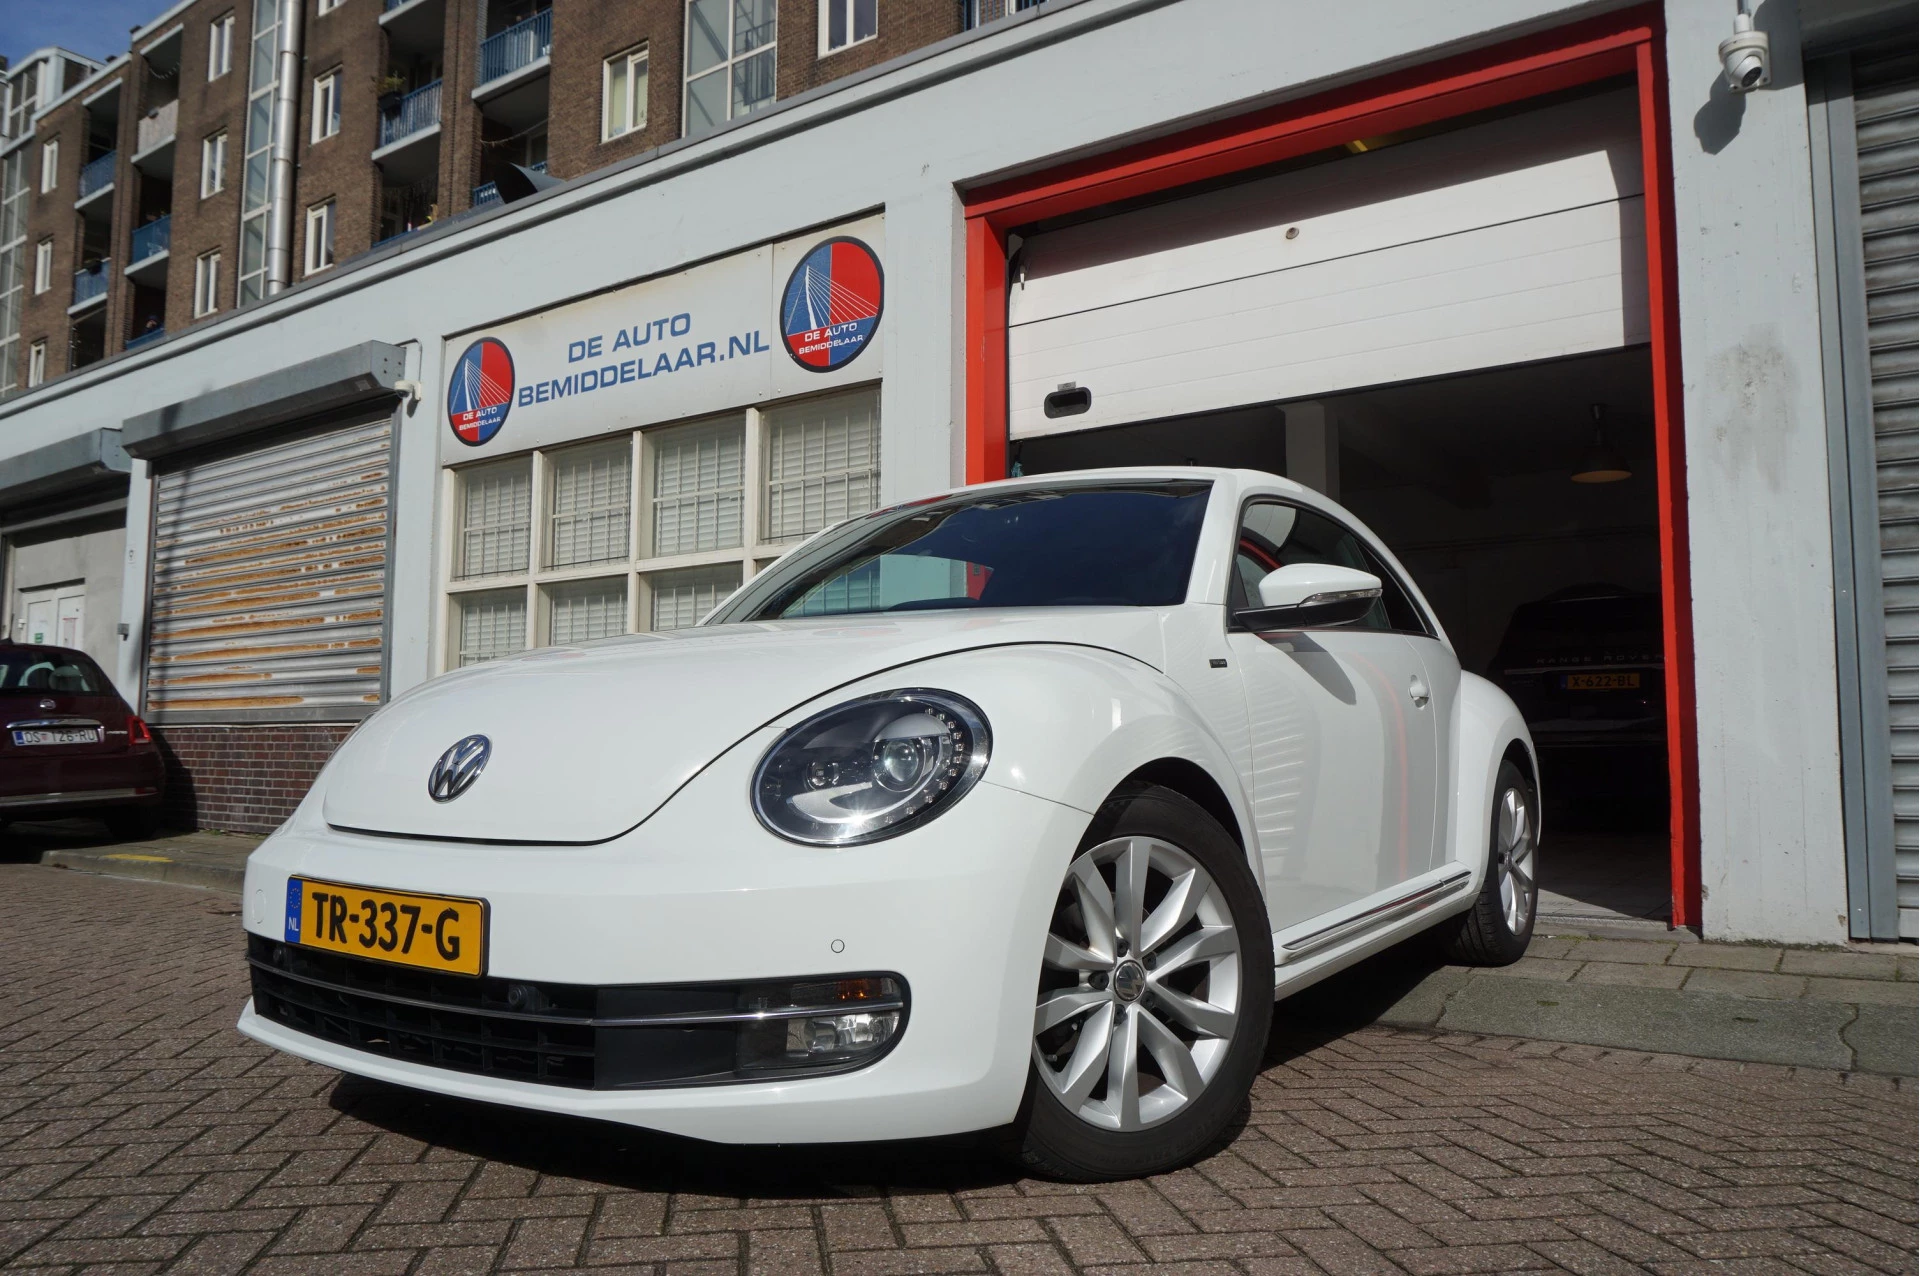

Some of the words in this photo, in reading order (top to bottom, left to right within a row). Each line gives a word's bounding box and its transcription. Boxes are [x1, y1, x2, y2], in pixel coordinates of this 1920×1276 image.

[568, 335, 603, 363] DE
[612, 313, 690, 352] AUTO
[804, 331, 821, 342] DE
[824, 322, 858, 338] AUTO
[799, 334, 863, 354] BEMIDDELAAR
[518, 330, 770, 408] BEMIDDELAAR.NL
[459, 416, 501, 431] BEMIDDELAAR
[463, 412, 475, 421] DE
[476, 406, 498, 418] AUTO
[1572, 675, 1635, 688] X-622-BL
[288, 916, 300, 932] NL
[311, 892, 461, 962] TR-337-G
